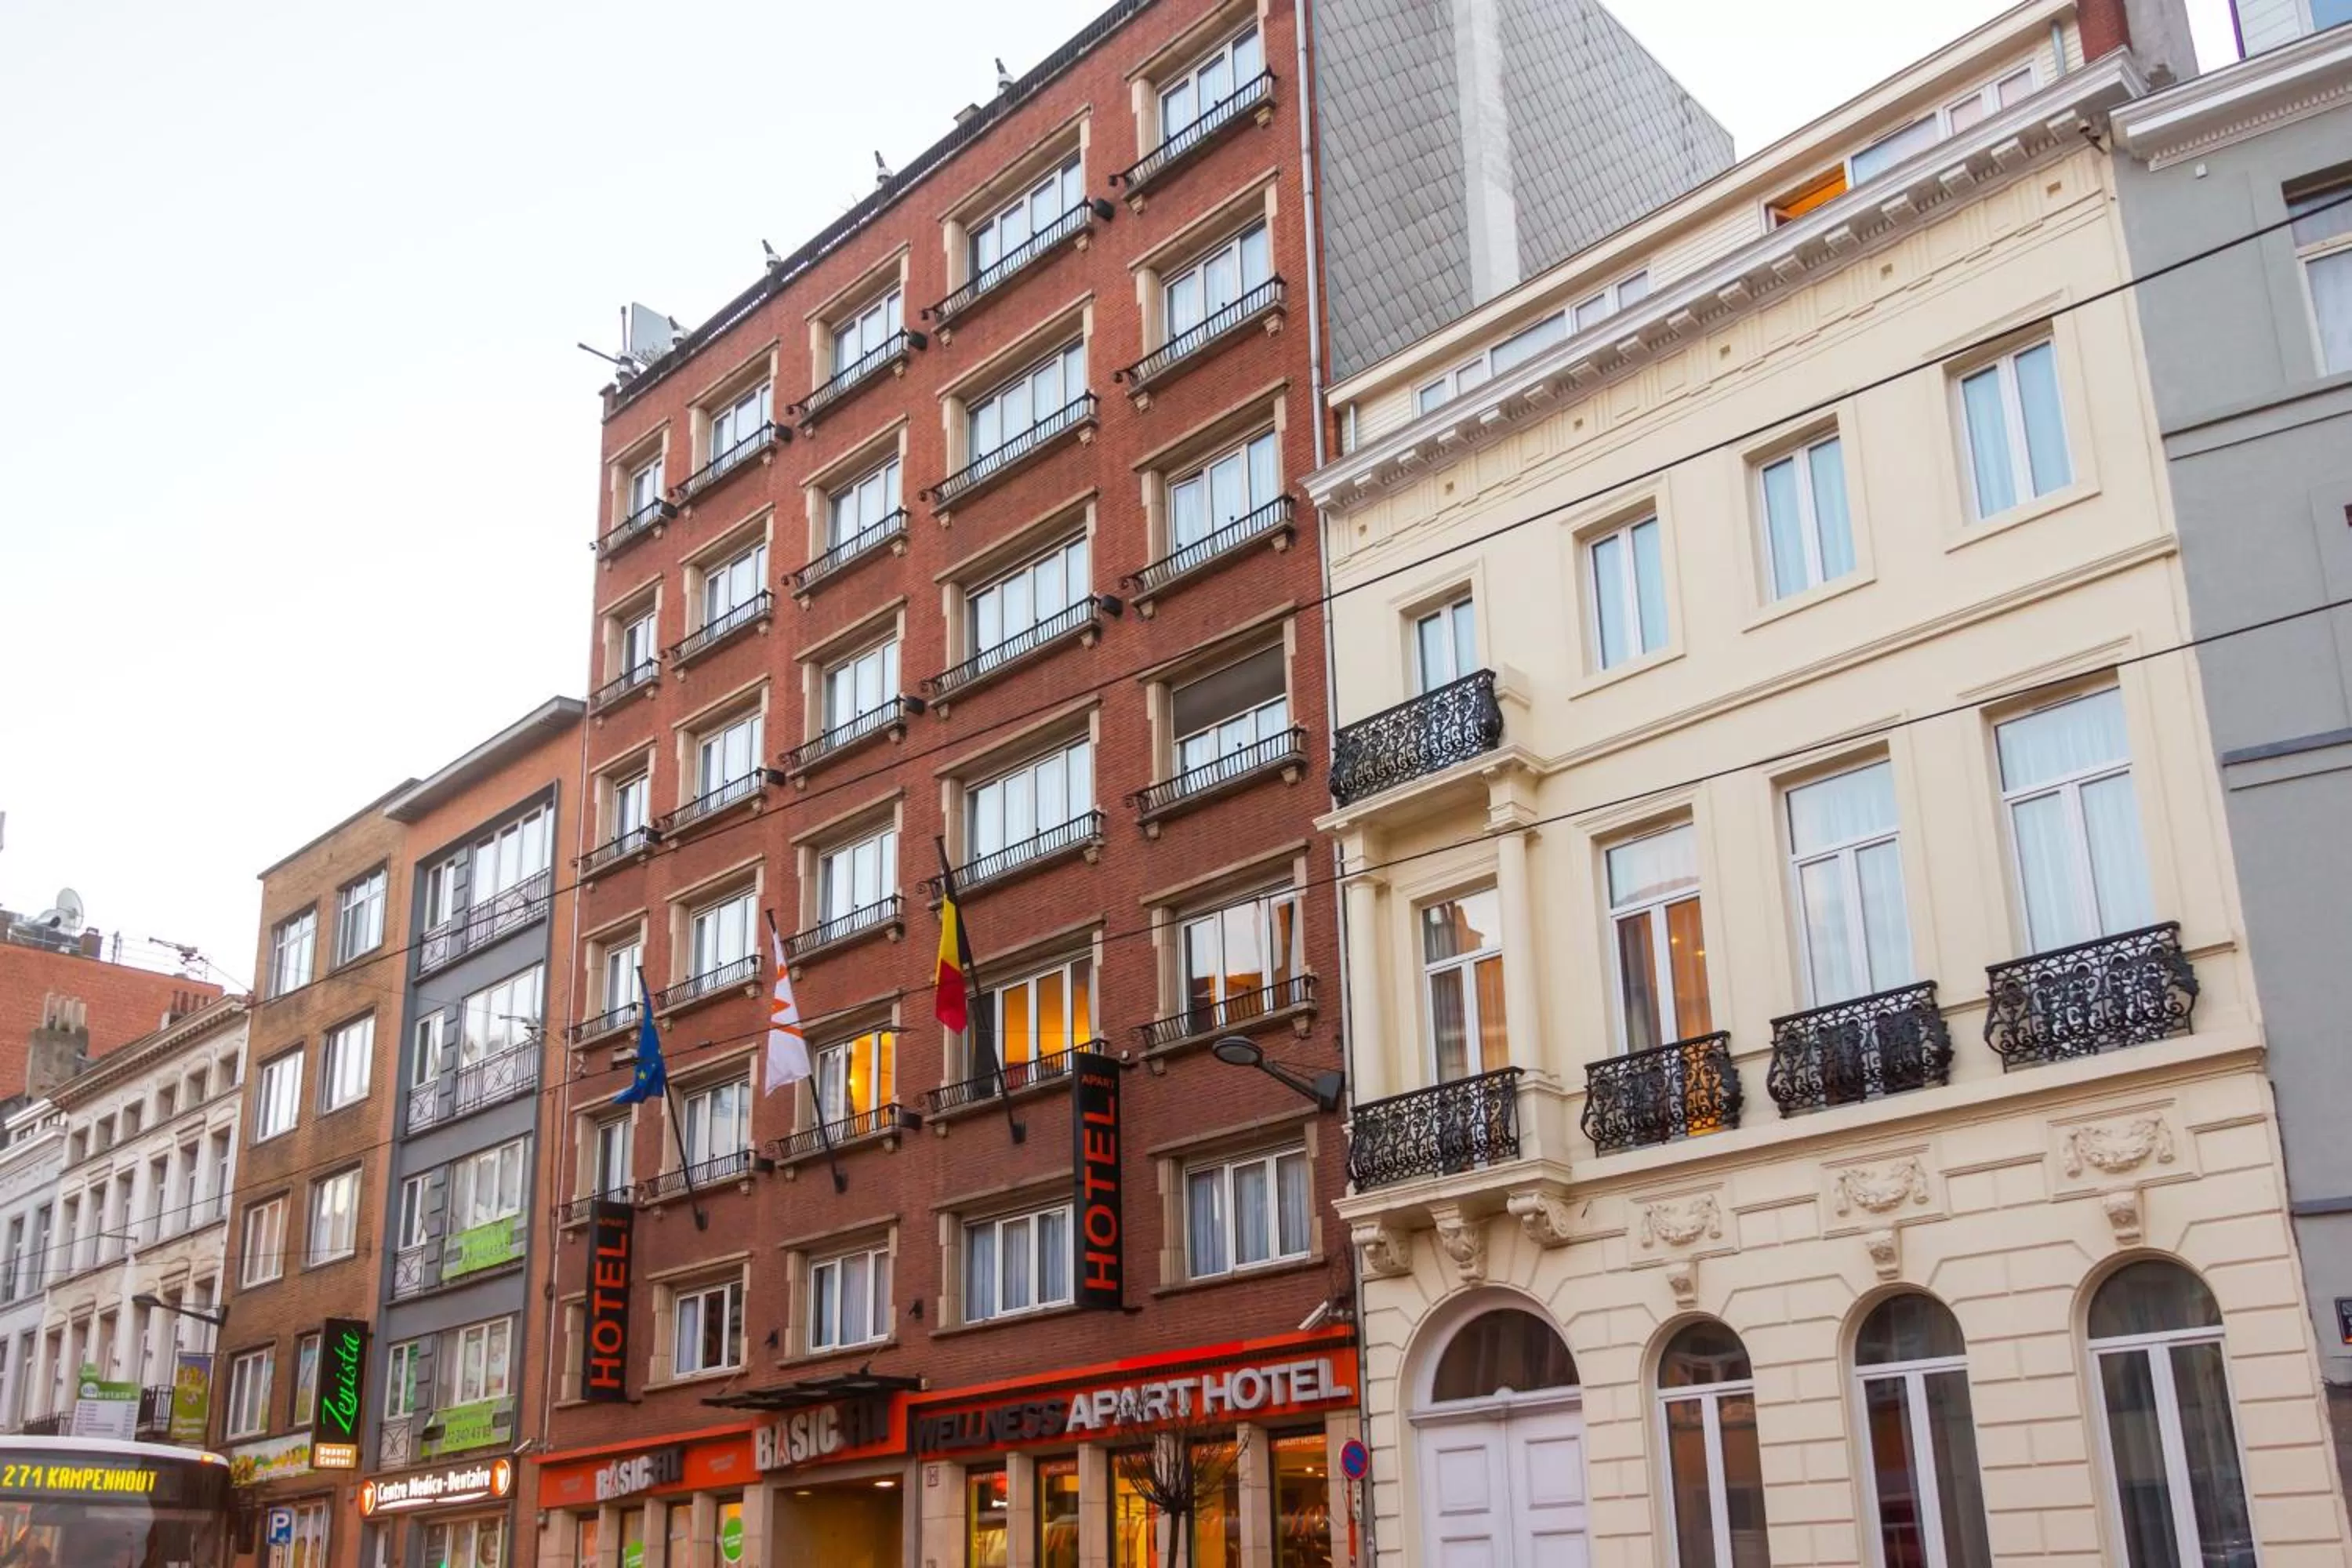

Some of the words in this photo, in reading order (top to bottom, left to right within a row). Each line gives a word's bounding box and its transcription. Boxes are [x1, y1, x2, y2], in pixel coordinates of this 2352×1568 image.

[1083, 1095, 1118, 1290] HOTEL
[589, 1232, 628, 1388] HOTEL
[916, 1399, 1065, 1452] WELLNESS
[1065, 1377, 1201, 1432] APART
[1201, 1358, 1352, 1413] HOTEL
[755, 1403, 841, 1471] BASIC
[2, 1463, 44, 1488] 271
[46, 1465, 158, 1493] KAMPENHOUT
[377, 1480, 408, 1502] Centre
[596, 1456, 652, 1501] BASIC
[271, 1512, 291, 1539] P
